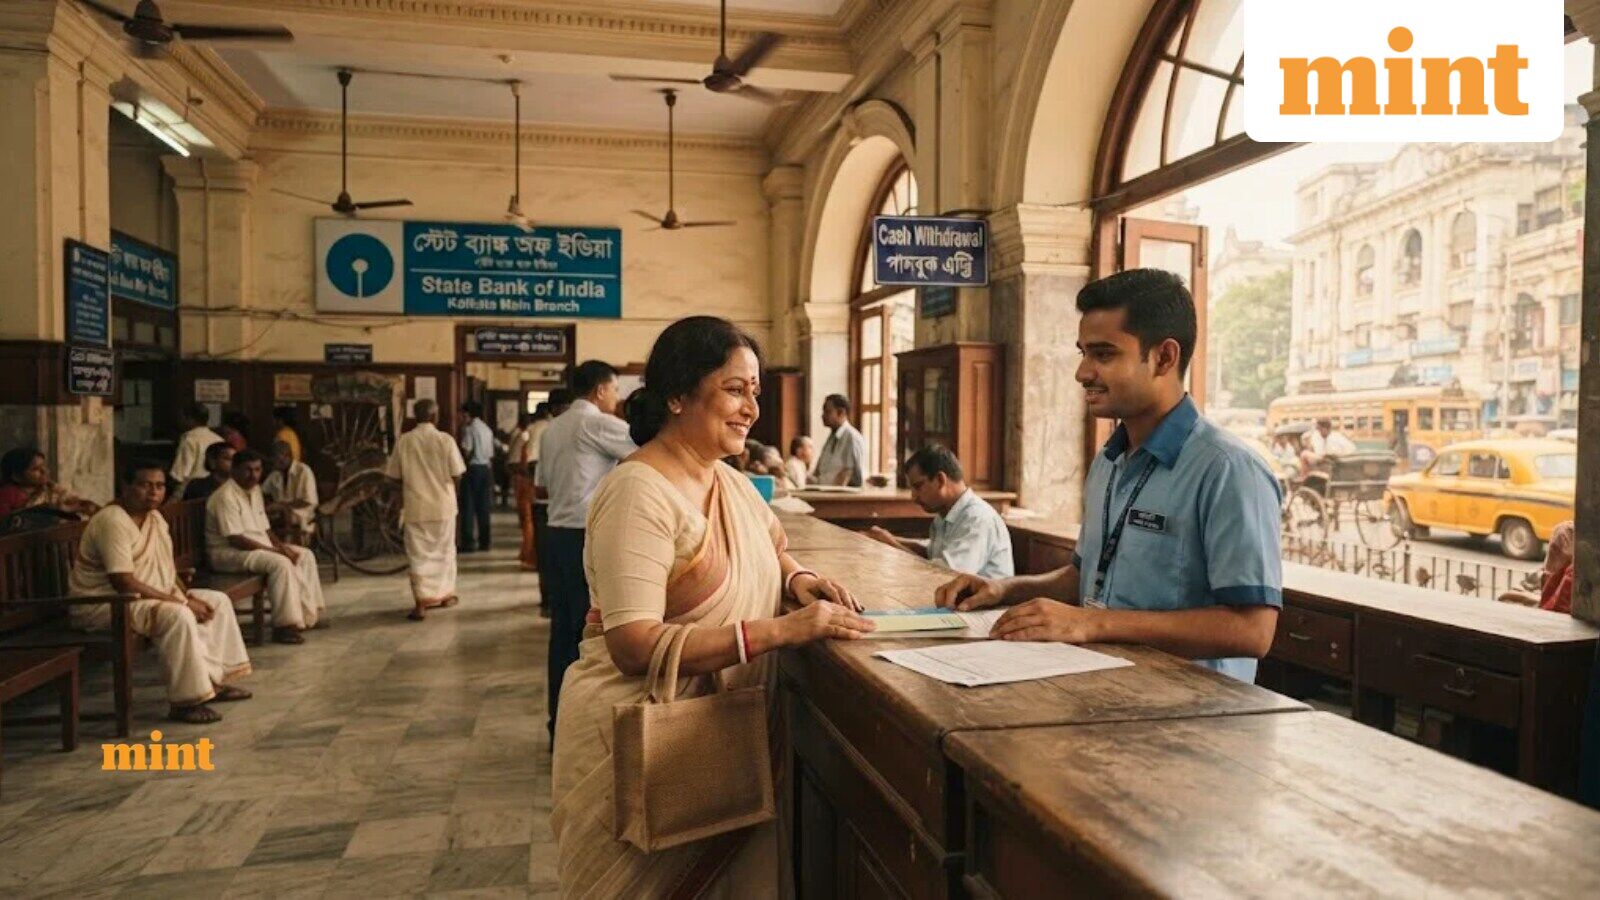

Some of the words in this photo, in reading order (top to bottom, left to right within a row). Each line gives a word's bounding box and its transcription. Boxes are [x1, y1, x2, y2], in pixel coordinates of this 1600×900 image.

[878, 224, 912, 246] Cash
[914, 225, 983, 248] Withdrawal
[421, 276, 473, 294] State
[478, 278, 529, 296] Bank
[534, 280, 554, 296] of
[559, 280, 605, 298] India
[534, 299, 580, 312] Branch
